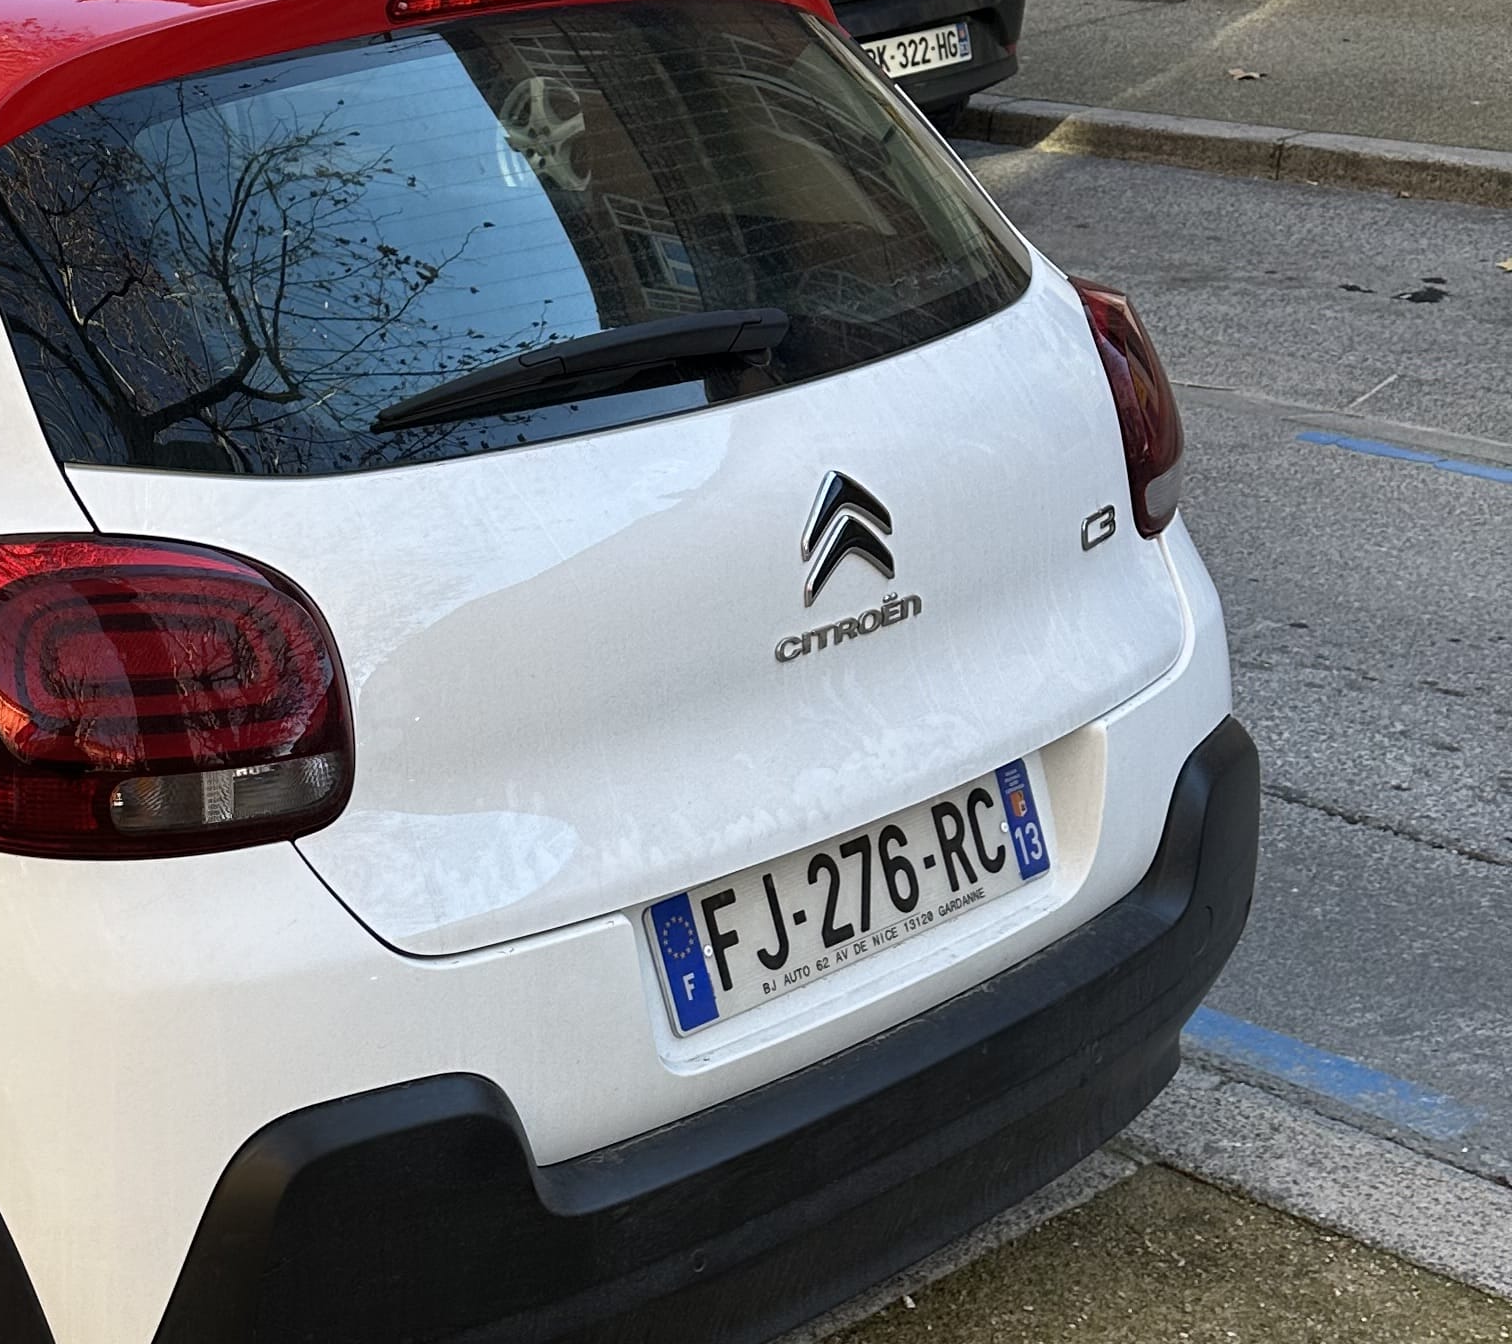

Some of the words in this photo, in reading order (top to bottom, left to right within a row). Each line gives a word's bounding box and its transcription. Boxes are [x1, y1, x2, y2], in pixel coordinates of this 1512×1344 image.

[1081, 505, 1116, 551] C3
[1014, 822, 1043, 865] 13
[700, 787, 1006, 992] FJ-276-RC
[762, 979, 777, 995] BJ
[783, 965, 811, 986] AUTO
[815, 956, 831, 972] 62
[835, 948, 849, 964] AV
[853, 940, 868, 956] DE
[872, 926, 899, 947] NICE
[903, 911, 934, 933] 13120
[937, 887, 986, 918] GARDANNE
[682, 972, 695, 1001] F
